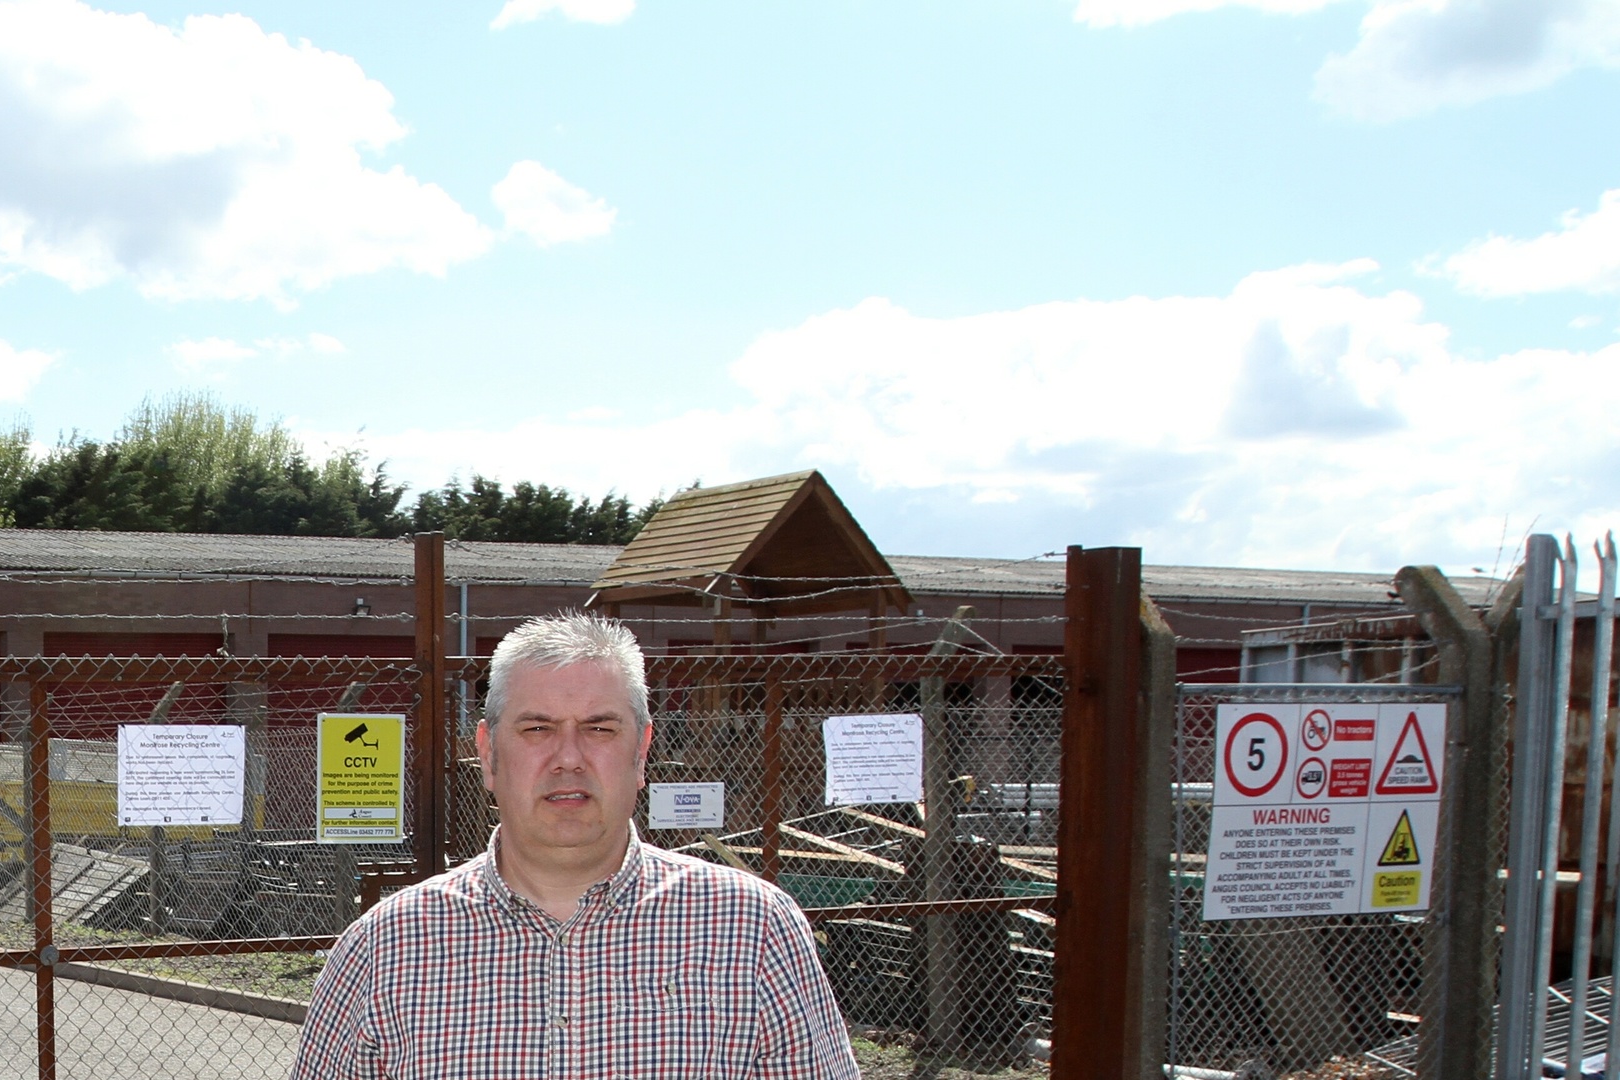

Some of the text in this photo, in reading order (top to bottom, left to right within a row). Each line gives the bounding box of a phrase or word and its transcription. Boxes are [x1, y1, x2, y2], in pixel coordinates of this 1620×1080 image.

[1247, 738, 1265, 771] 5
[344, 757, 377, 768] CCTV
[1253, 808, 1330, 825] WARNING
[1224, 829, 1254, 838] ANYONE
[1256, 828, 1292, 837] ENTERING
[1320, 826, 1355, 835] PREMISES
[1236, 840, 1256, 848] DOES
[1220, 851, 1257, 860] CHILDREN
[1259, 850, 1280, 858] MUST
[1281, 850, 1291, 858] BE
[1293, 849, 1312, 858] KEPT
[1314, 848, 1338, 857] UNDER
[1237, 862, 1262, 870] STRICT
[1265, 861, 1313, 869] SUPERVISION
[1217, 872, 1276, 882] ACCOMPANYING
[1278, 871, 1302, 880] ADULT
[1379, 875, 1415, 887] Caution
[1212, 884, 1238, 893] ANGUS
[1240, 884, 1272, 892] COUNCIL
[1274, 882, 1308, 890] ACCEPTS
[1322, 880, 1355, 889] LIABILITY
[1238, 894, 1281, 903] NEGLIGENT
[1282, 893, 1301, 901] ACTS
[1314, 891, 1344, 899] ANYONE
[1295, 902, 1332, 911] PREMISES.
